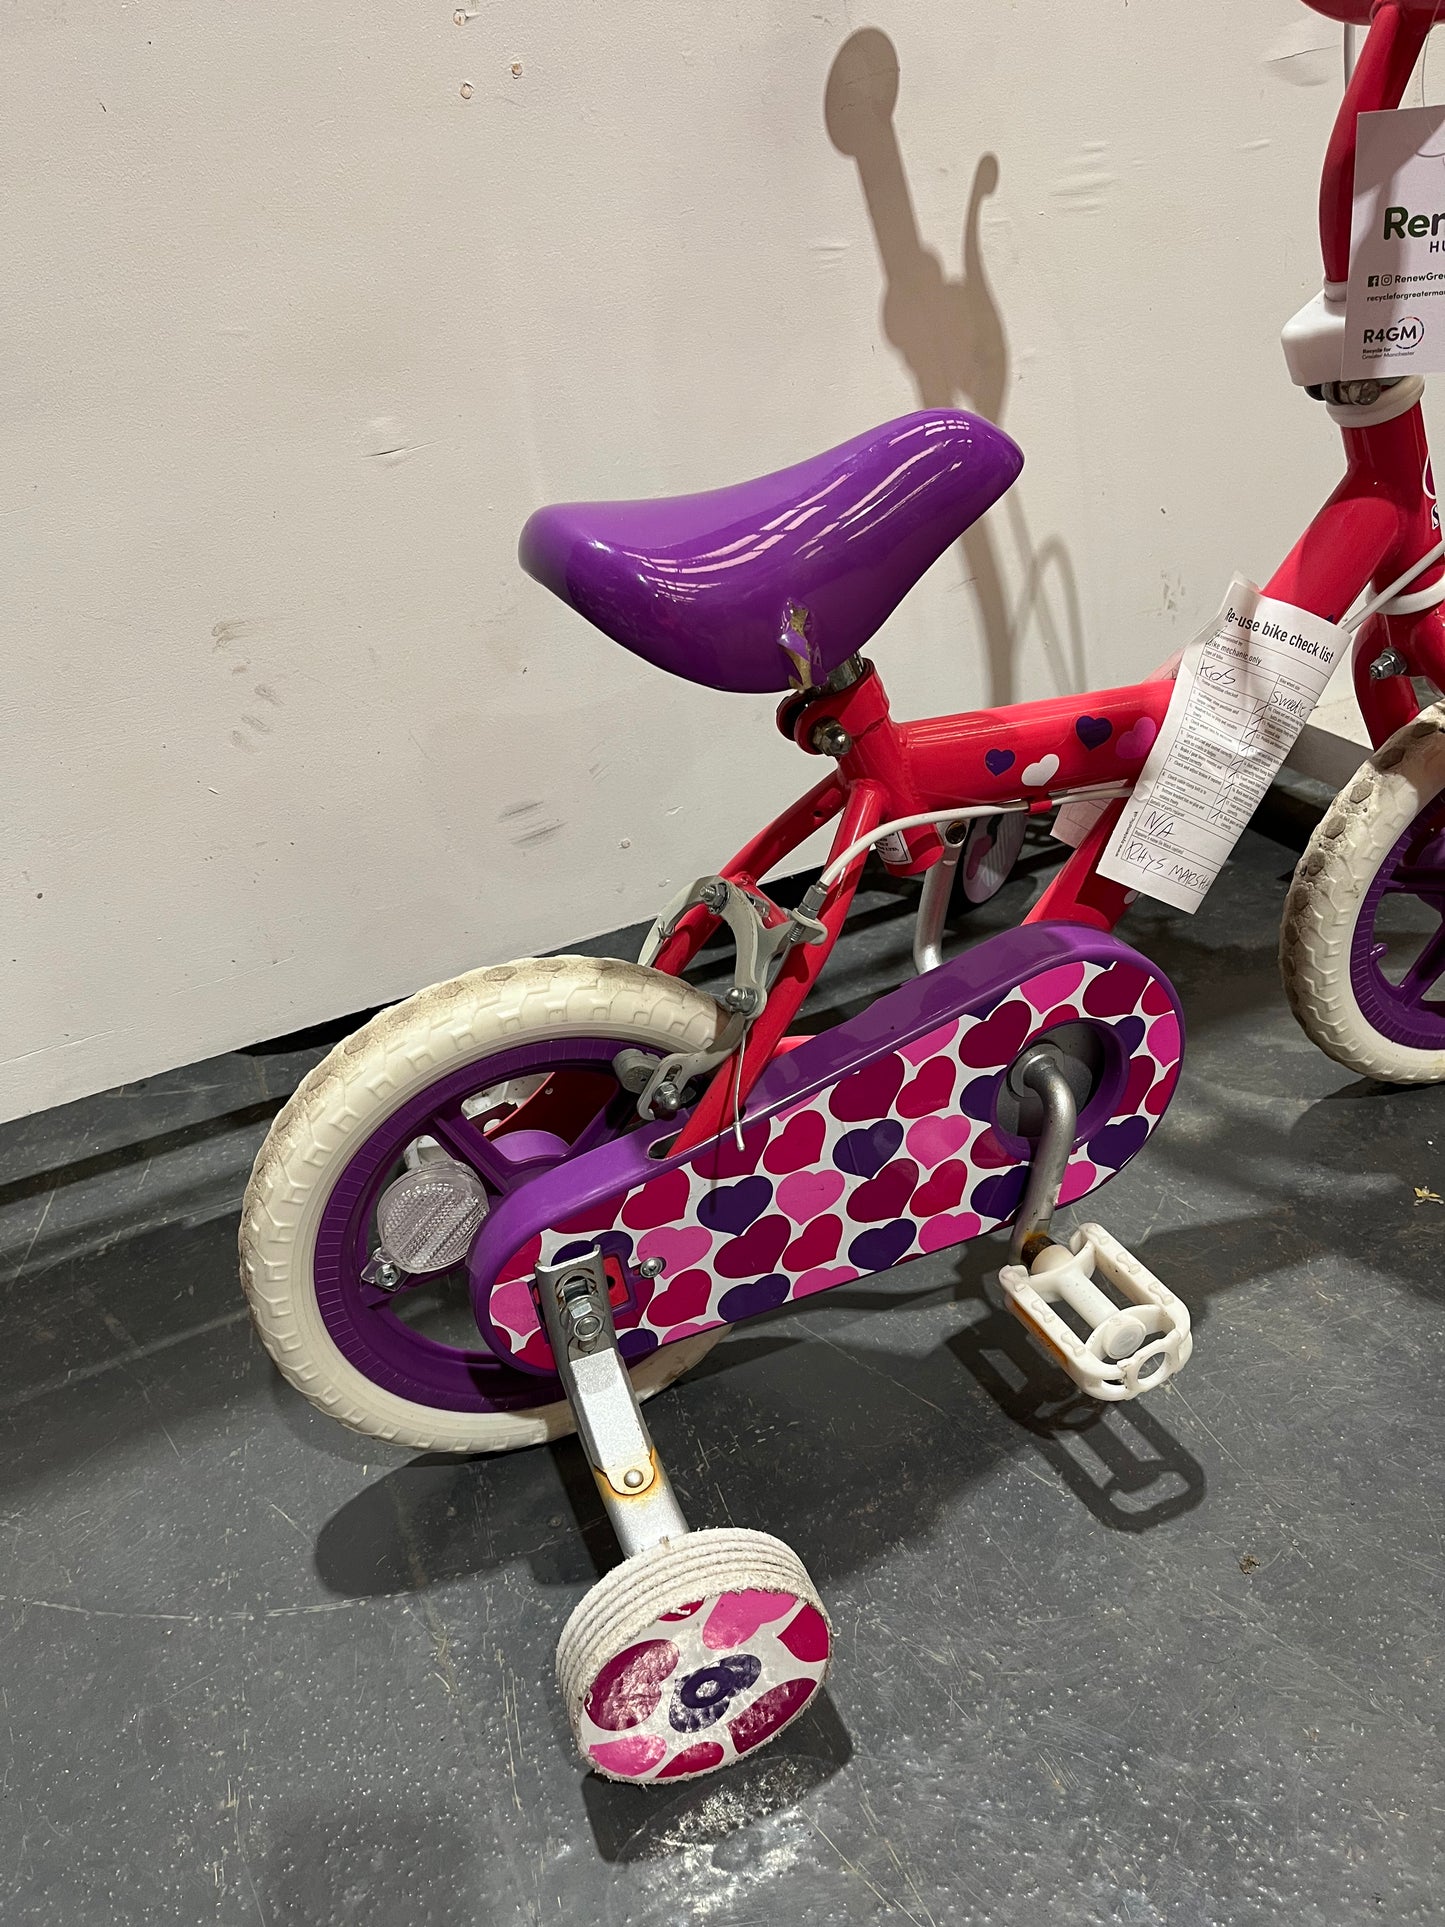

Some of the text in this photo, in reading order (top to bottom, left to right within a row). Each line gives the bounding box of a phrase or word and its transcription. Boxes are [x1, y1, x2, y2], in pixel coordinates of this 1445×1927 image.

[1363, 325, 1416, 344] R4GM
[1225, 607, 1260, 632] Re-use
[1262, 622, 1288, 642] bike
[1289, 634, 1320, 656] check
[1320, 646, 1334, 664] list
[1220, 646, 1248, 660] mechanic
[1248, 656, 1262, 666] only
[1144, 810, 1176, 838] N/A
